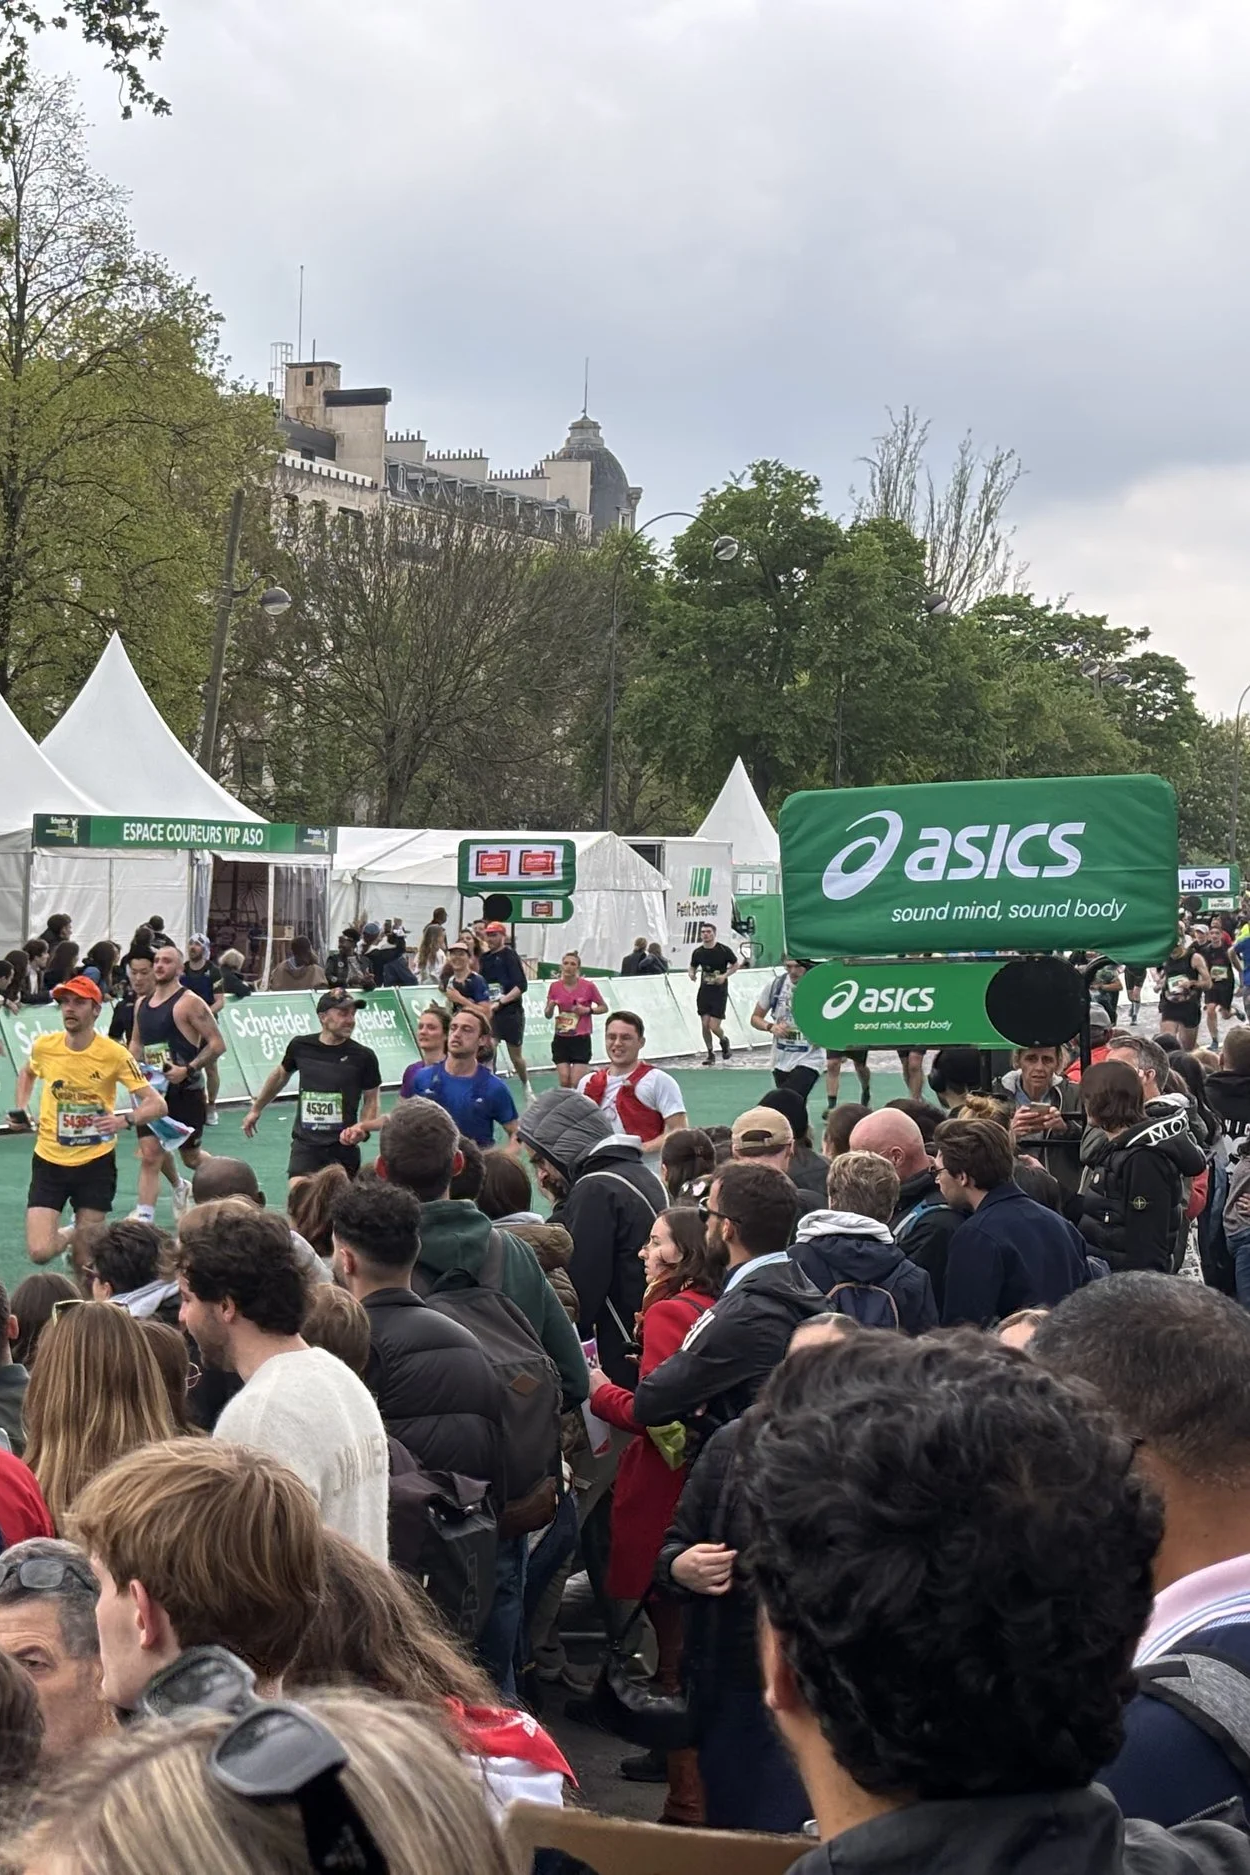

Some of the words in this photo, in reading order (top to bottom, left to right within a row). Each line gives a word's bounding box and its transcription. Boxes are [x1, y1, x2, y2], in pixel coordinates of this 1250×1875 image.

[123, 822, 164, 842] ESPACE
[166, 823, 222, 844] COUREURS
[224, 826, 240, 845] VIP
[241, 827, 264, 847] ASO
[904, 822, 1086, 882] asics
[1181, 878, 1225, 890] HiPRO
[676, 902, 691, 917] Petit
[891, 902, 949, 922] sound
[952, 900, 1003, 921] mind,
[1008, 900, 1070, 919] sound
[1074, 898, 1127, 921] body
[858, 987, 935, 1013] asics
[230, 1004, 311, 1038] Schneider
[853, 1021, 879, 1031] sound
[903, 1020, 930, 1030] sound
[930, 1020, 954, 1031] body
[307, 1102, 333, 1116] 45320
